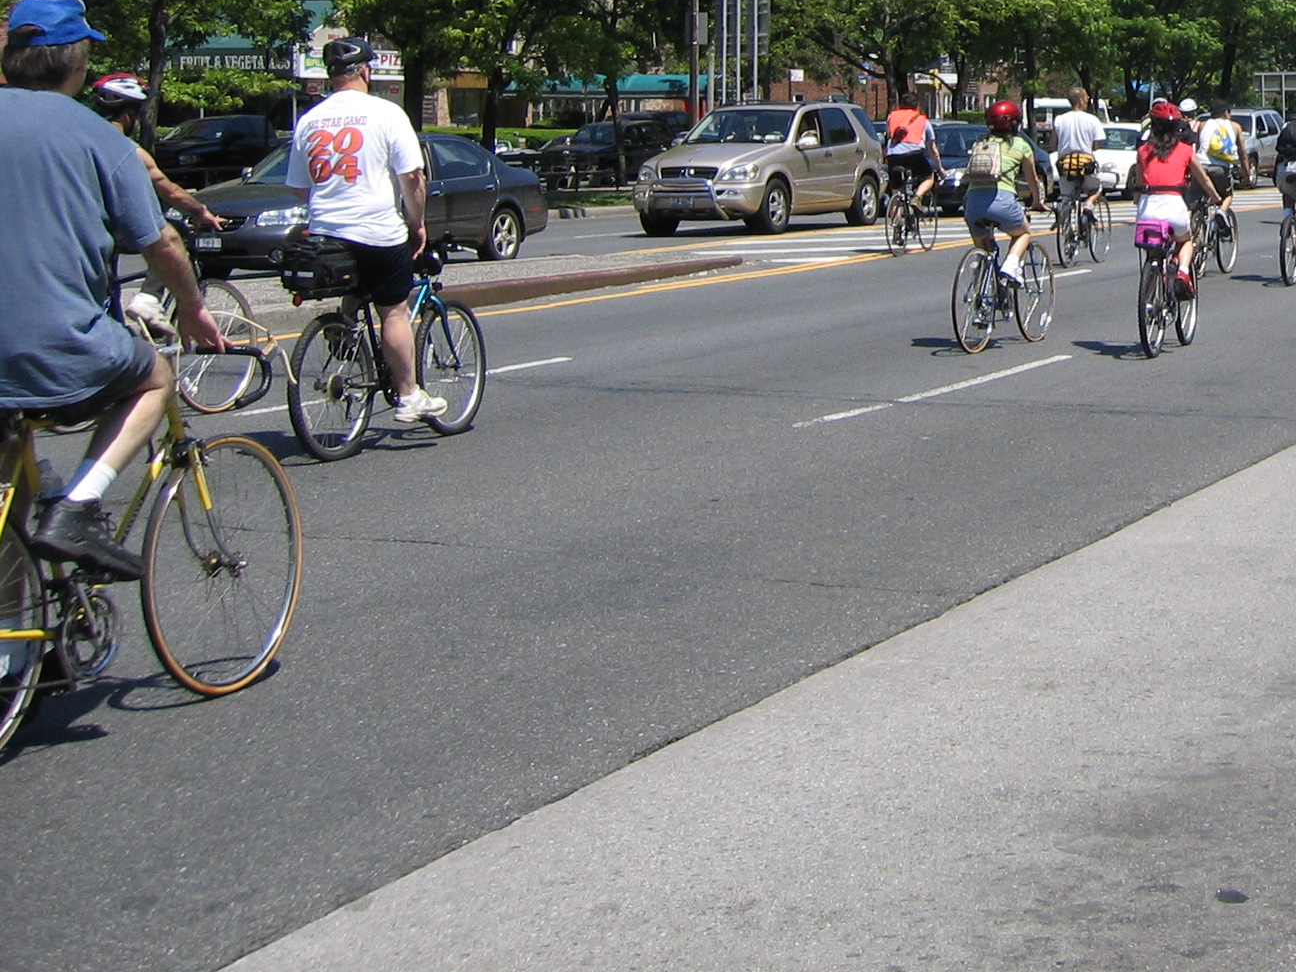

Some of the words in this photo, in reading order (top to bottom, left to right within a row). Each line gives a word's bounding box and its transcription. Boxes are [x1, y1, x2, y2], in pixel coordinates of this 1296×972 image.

[380, 54, 403, 66] PIZ
[307, 127, 364, 157] 20
[308, 155, 362, 184] 04
